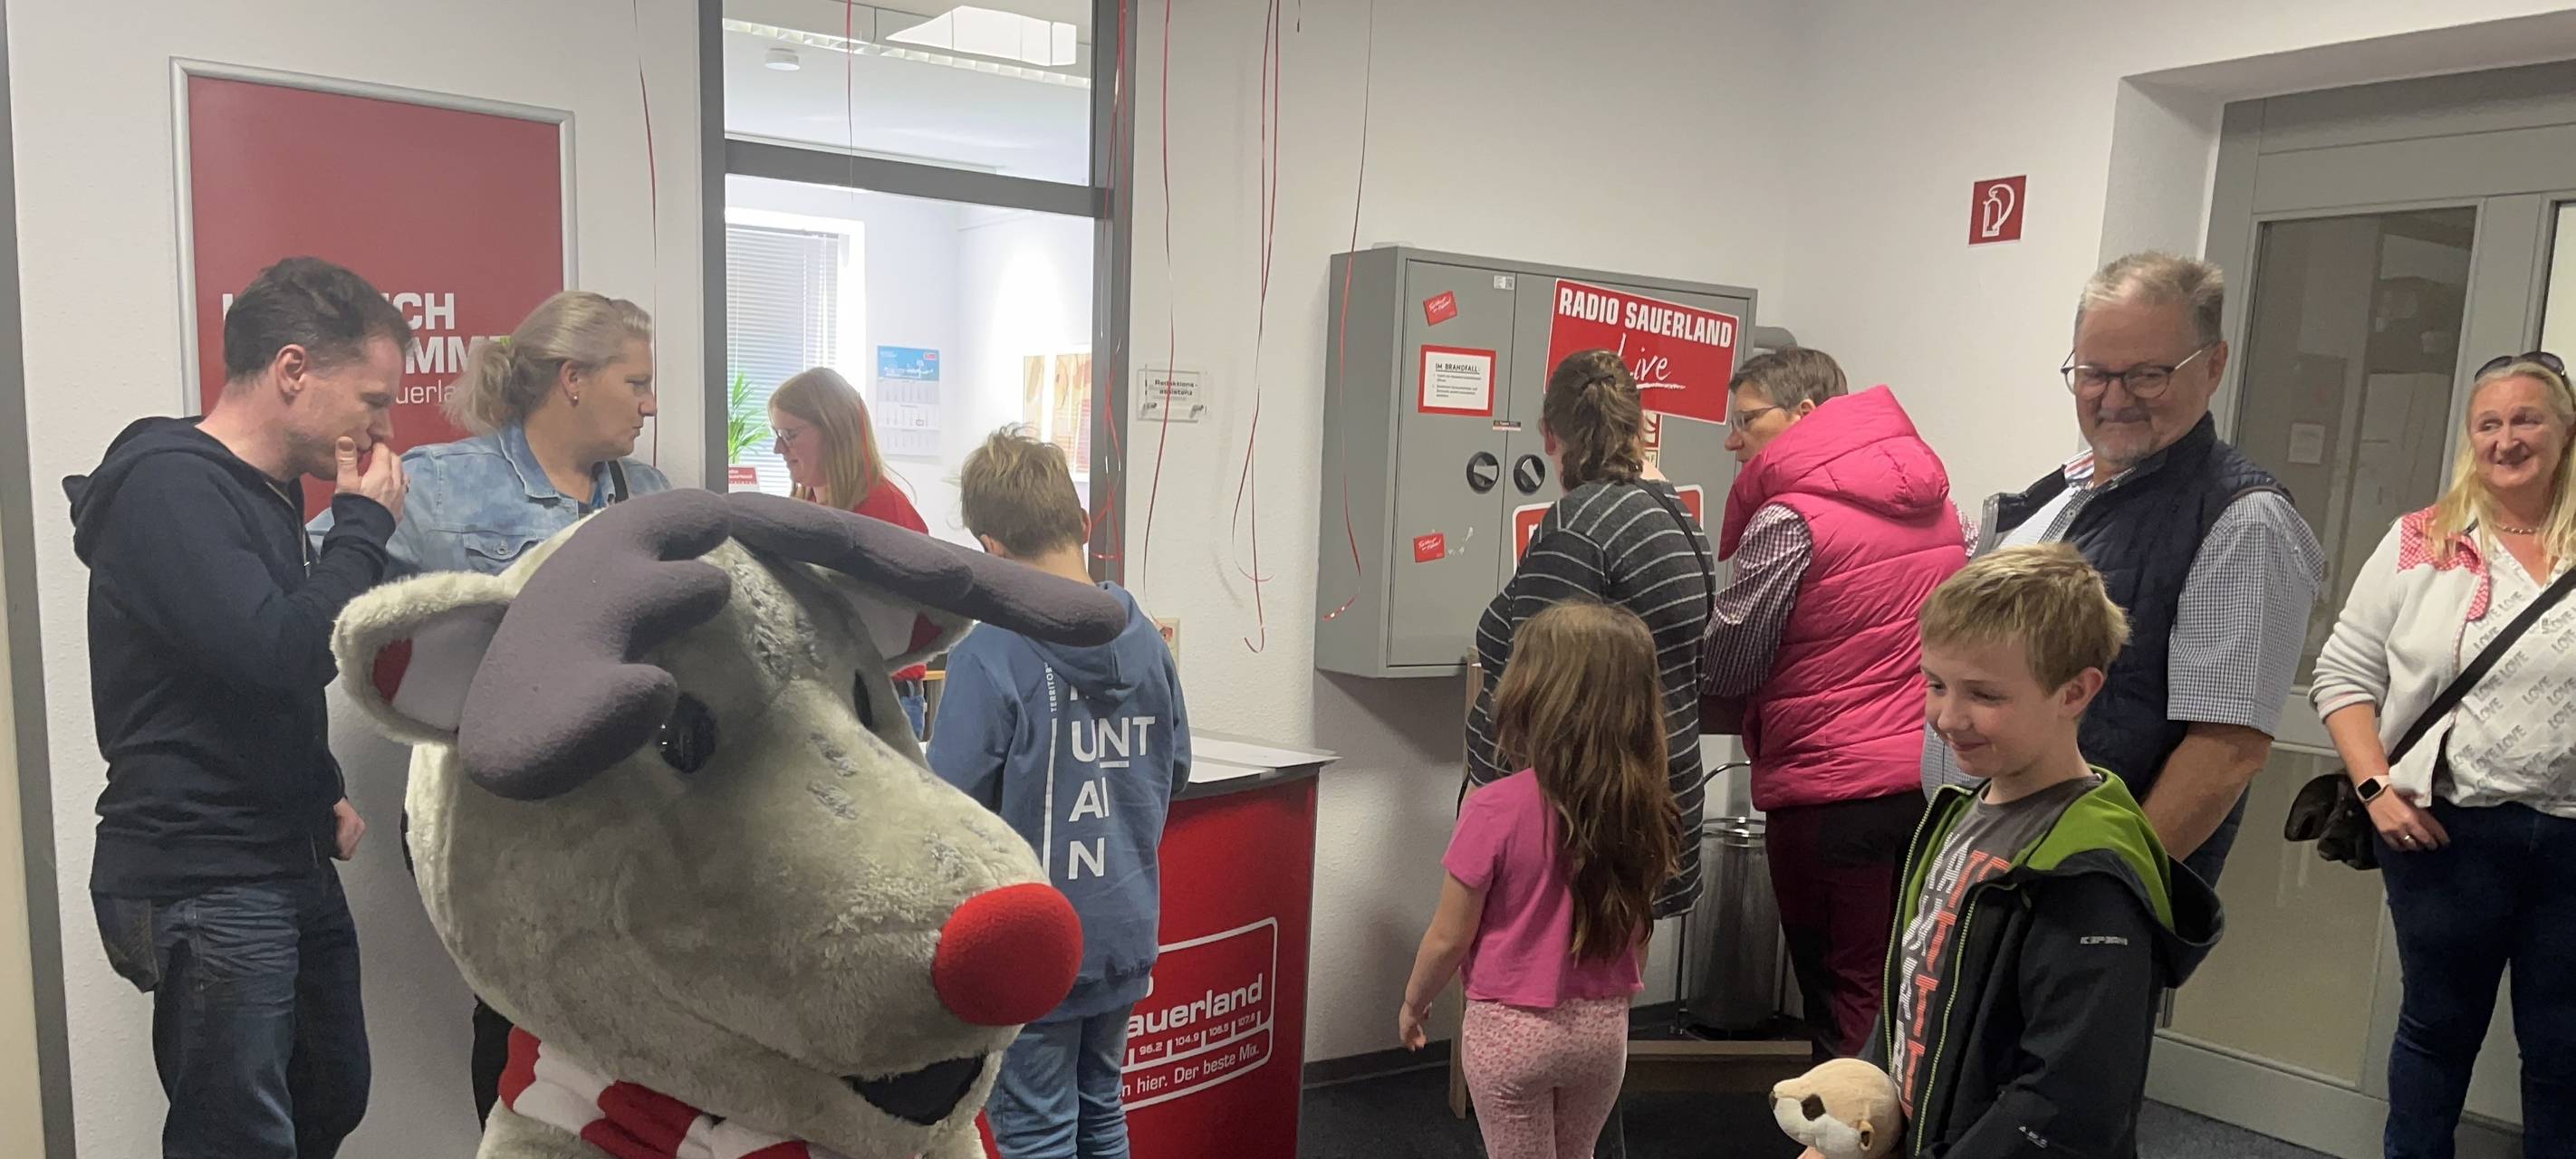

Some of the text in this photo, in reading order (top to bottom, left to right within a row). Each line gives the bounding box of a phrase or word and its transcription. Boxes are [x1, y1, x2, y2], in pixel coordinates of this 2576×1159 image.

[1558, 287, 1733, 349] RADIO SAUERLAND
[396, 378, 457, 405] uerla
[2499, 650, 2529, 678] LOVE
[2522, 675, 2552, 704] LOVE
[1072, 716, 1156, 762] UNT
[2496, 724, 2527, 753] LOVE
[1068, 838, 1105, 880] N
[1127, 972, 1264, 1039] auerland
[1175, 1033, 1200, 1047] 104.9
[1137, 1076, 1168, 1094] hier.
[1174, 1064, 1200, 1084] Der
[1203, 1055, 1235, 1075] beste
[1239, 1043, 1260, 1062] Mix.
